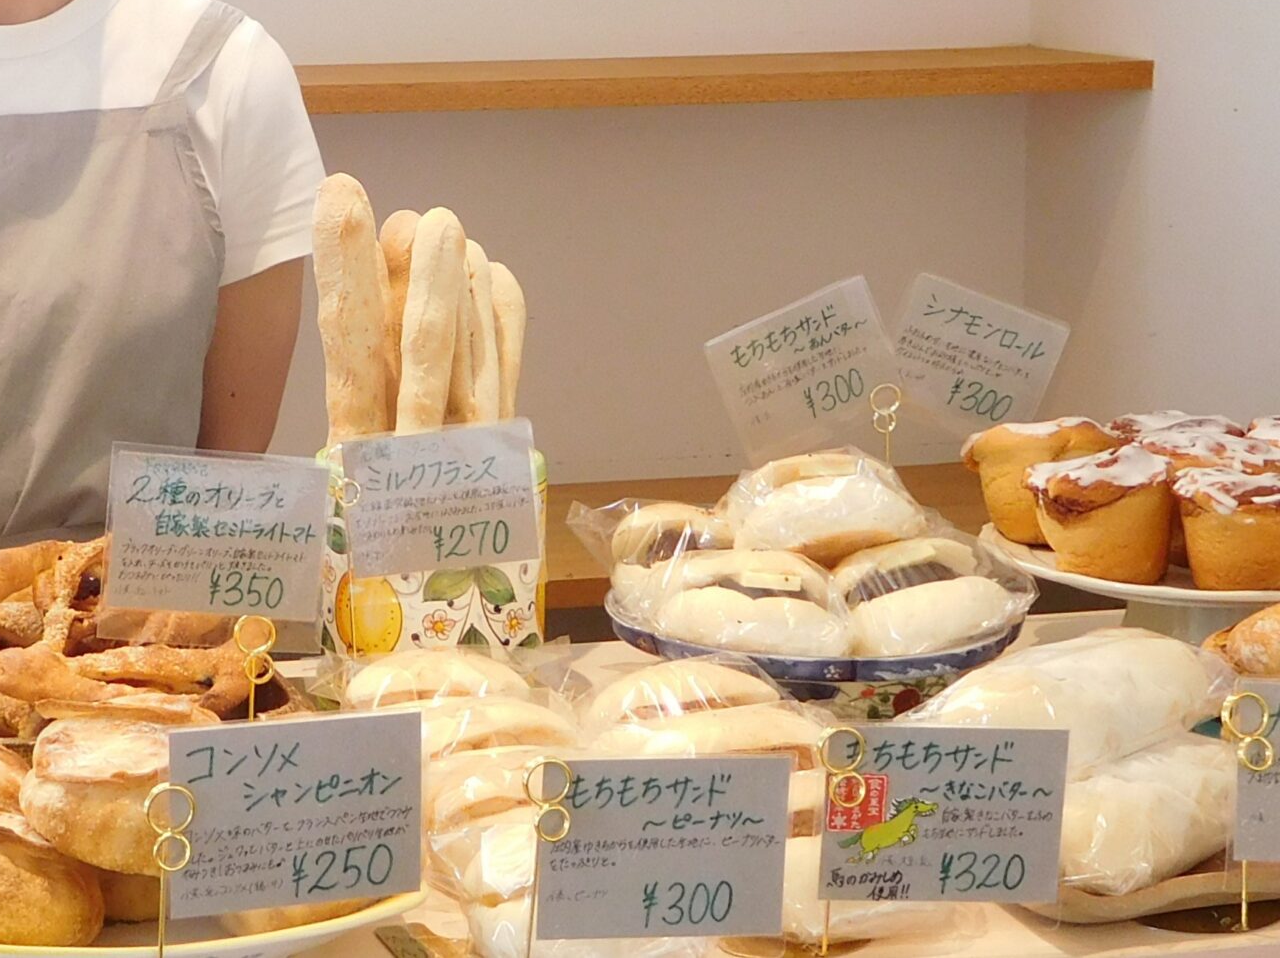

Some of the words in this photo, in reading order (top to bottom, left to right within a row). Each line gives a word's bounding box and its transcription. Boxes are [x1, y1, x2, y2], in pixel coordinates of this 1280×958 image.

[730, 304, 836, 368] もちもちサンド
[923, 294, 1045, 361] シナモンロール
[804, 368, 864, 419] ¥300
[946, 377, 1013, 422] ¥300
[126, 474, 286, 509] 2種のオリーブと
[366, 456, 498, 491] ミルクフランス
[155, 509, 316, 544] 自家製セミドライトマト
[434, 519, 510, 562] ¥270
[209, 567, 283, 609] ¥350
[186, 742, 300, 783] コンソメ
[243, 767, 402, 811] シャンピニオン
[567, 774, 732, 809] もちもちサンド
[292, 843, 394, 898] ¥250
[939, 852, 1026, 894] ¥320
[643, 880, 733, 928] ¥300
